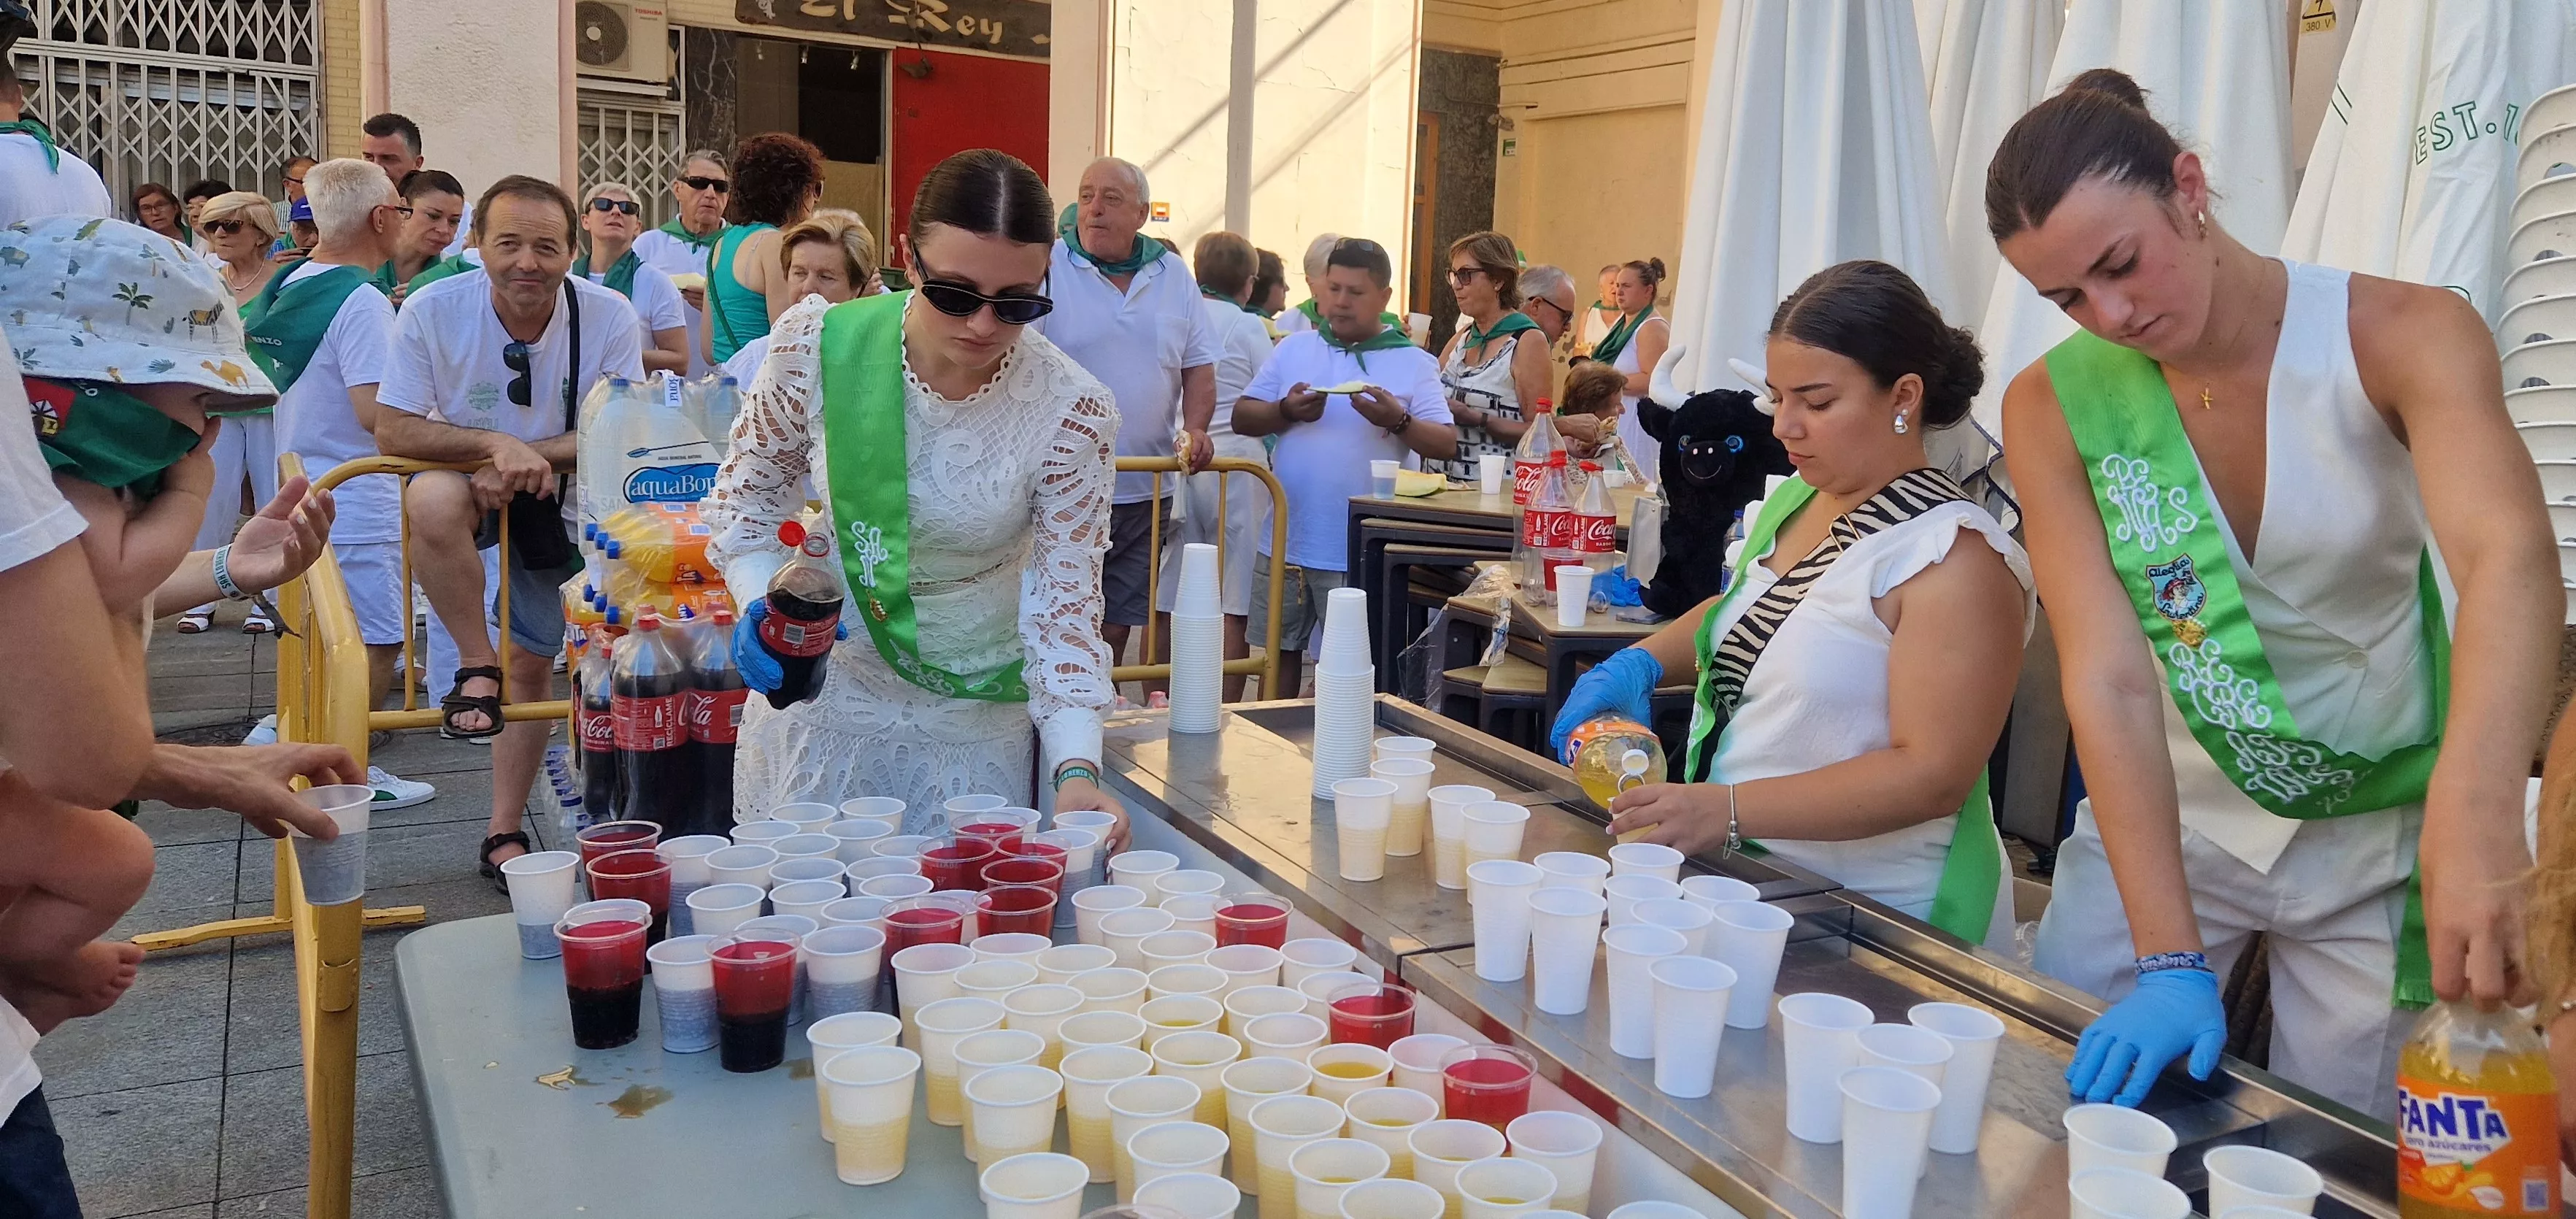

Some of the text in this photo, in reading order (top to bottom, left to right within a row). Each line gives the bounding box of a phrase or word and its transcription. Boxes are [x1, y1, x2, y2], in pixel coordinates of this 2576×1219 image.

[2306, 19, 2331, 31] 380 V
[631, 474, 717, 499] aquaBon
[665, 696, 674, 747] RECICLAME
[2398, 1089, 2507, 1140] FANTA
